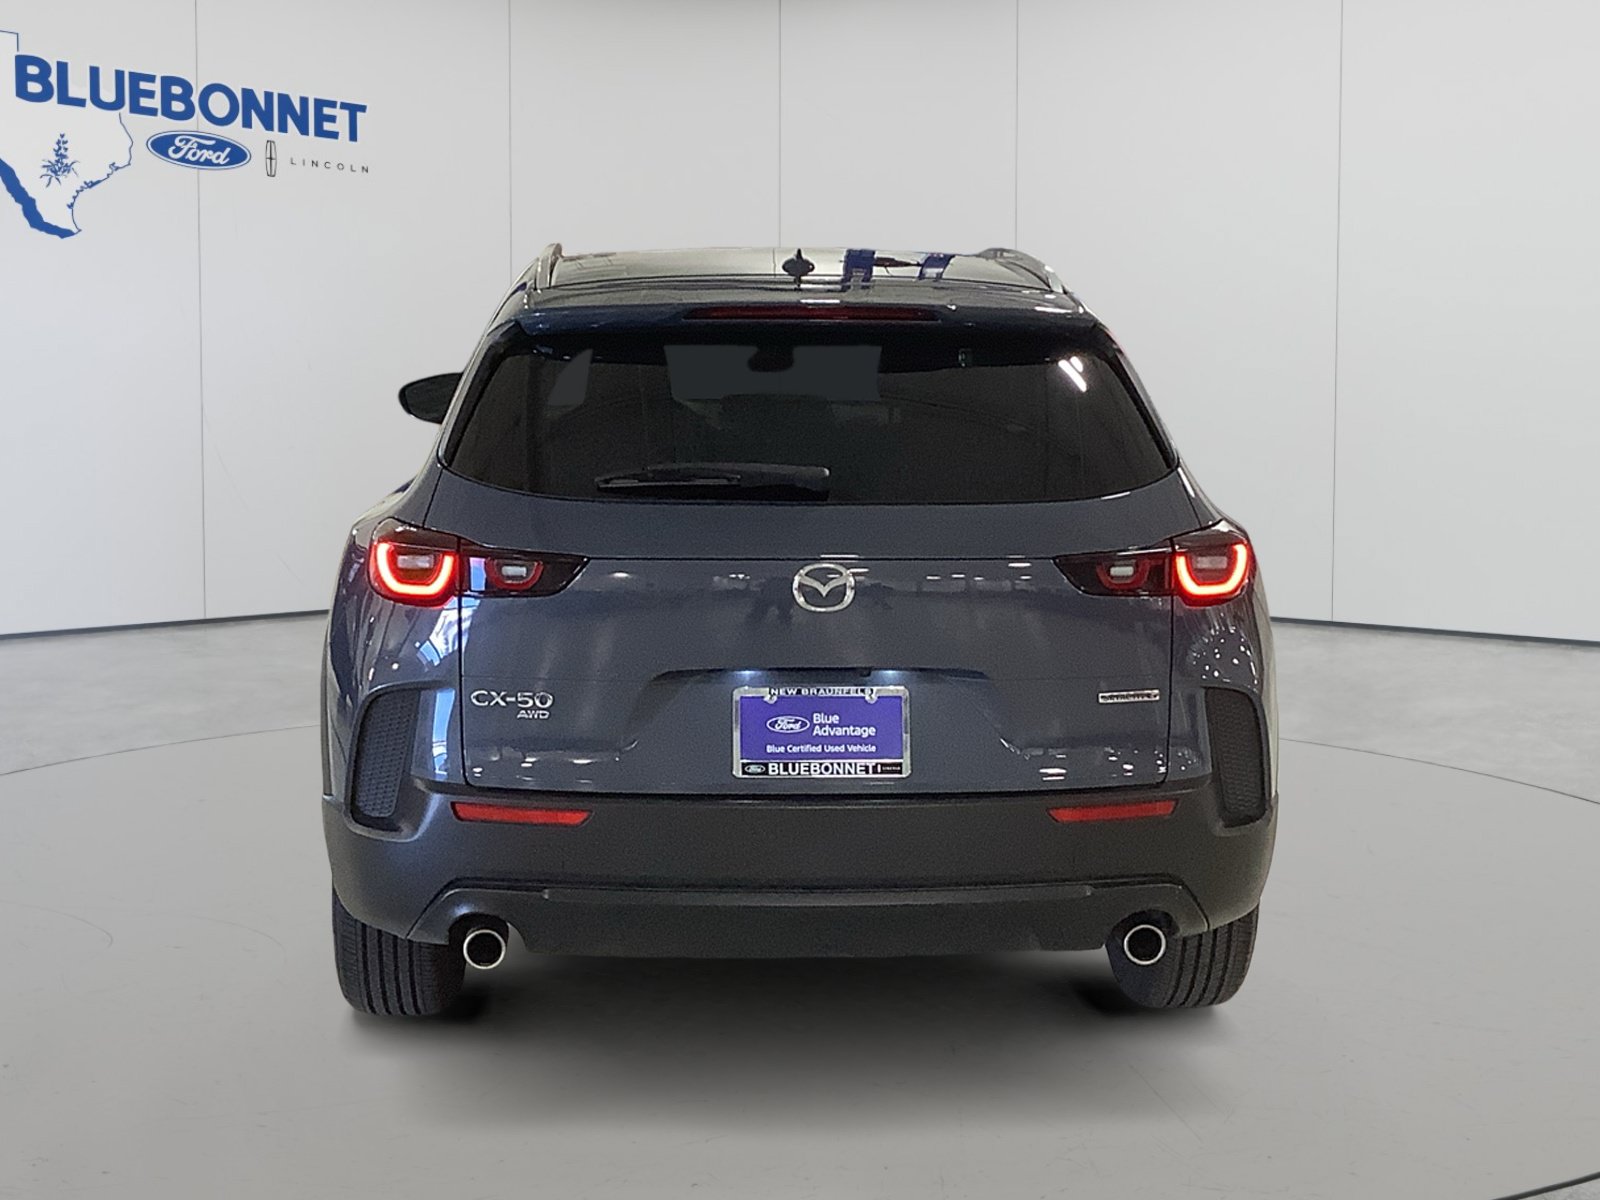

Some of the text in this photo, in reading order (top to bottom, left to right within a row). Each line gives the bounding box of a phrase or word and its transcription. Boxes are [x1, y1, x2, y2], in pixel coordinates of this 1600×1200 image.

[15, 54, 367, 142] BLUEBONNET
[290, 156, 370, 174] LINCOLN
[770, 687, 798, 696] NEW
[470, 689, 554, 709] CX-50
[516, 709, 550, 719] AWD
[812, 712, 840, 724] Blue
[812, 725, 876, 738] Advantage
[766, 743, 876, 753] Blue Certified Used Vehicle
[768, 762, 876, 776] BLUEBONNET
